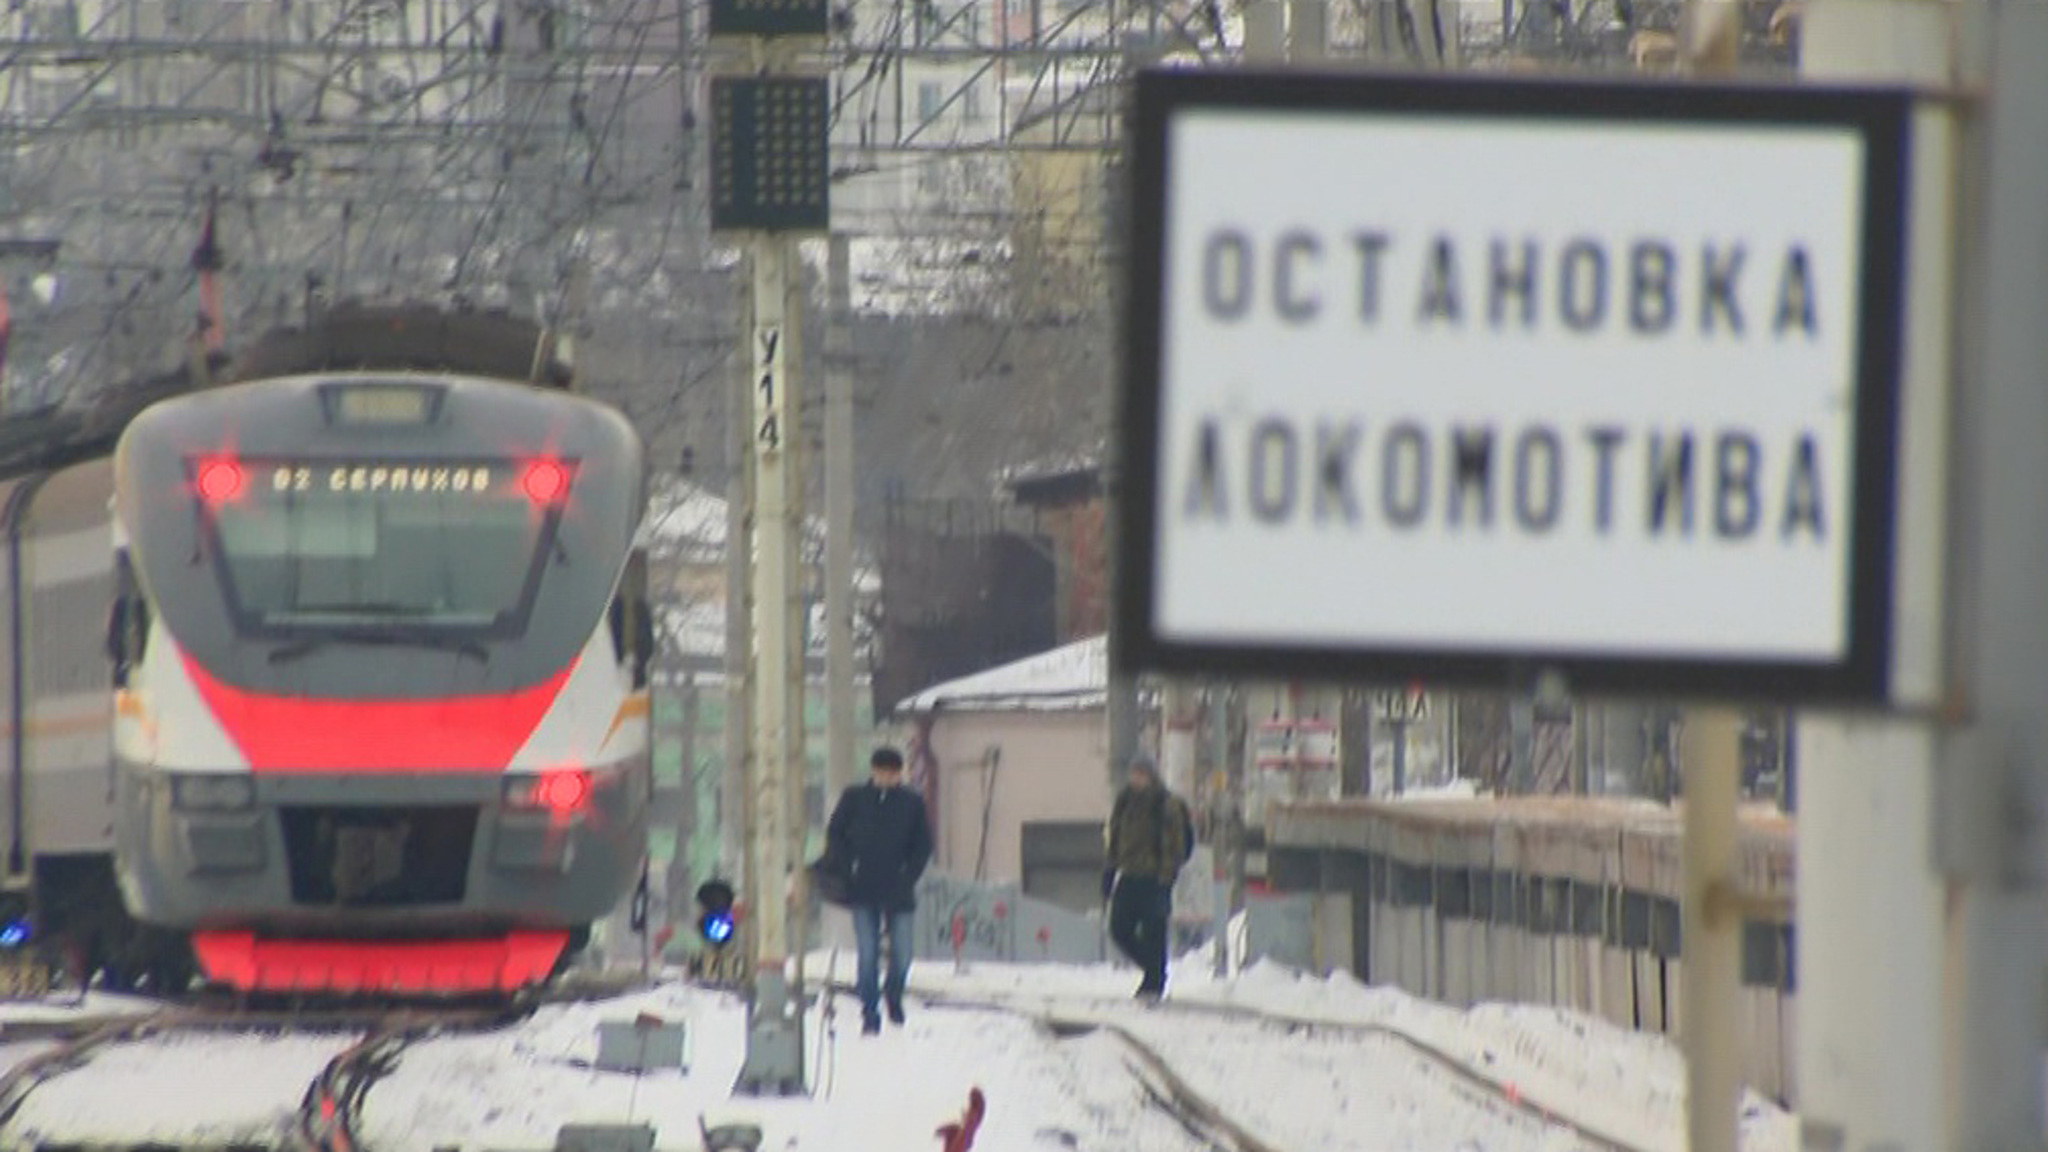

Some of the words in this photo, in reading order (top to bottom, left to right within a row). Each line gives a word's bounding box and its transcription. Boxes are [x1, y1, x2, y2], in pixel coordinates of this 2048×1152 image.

[1201, 228, 1819, 339] ОСТАНОВКА
[329, 466, 490, 491] СЕРПУХОВ
[1182, 415, 1827, 543] ЛОКОМОТИВА
